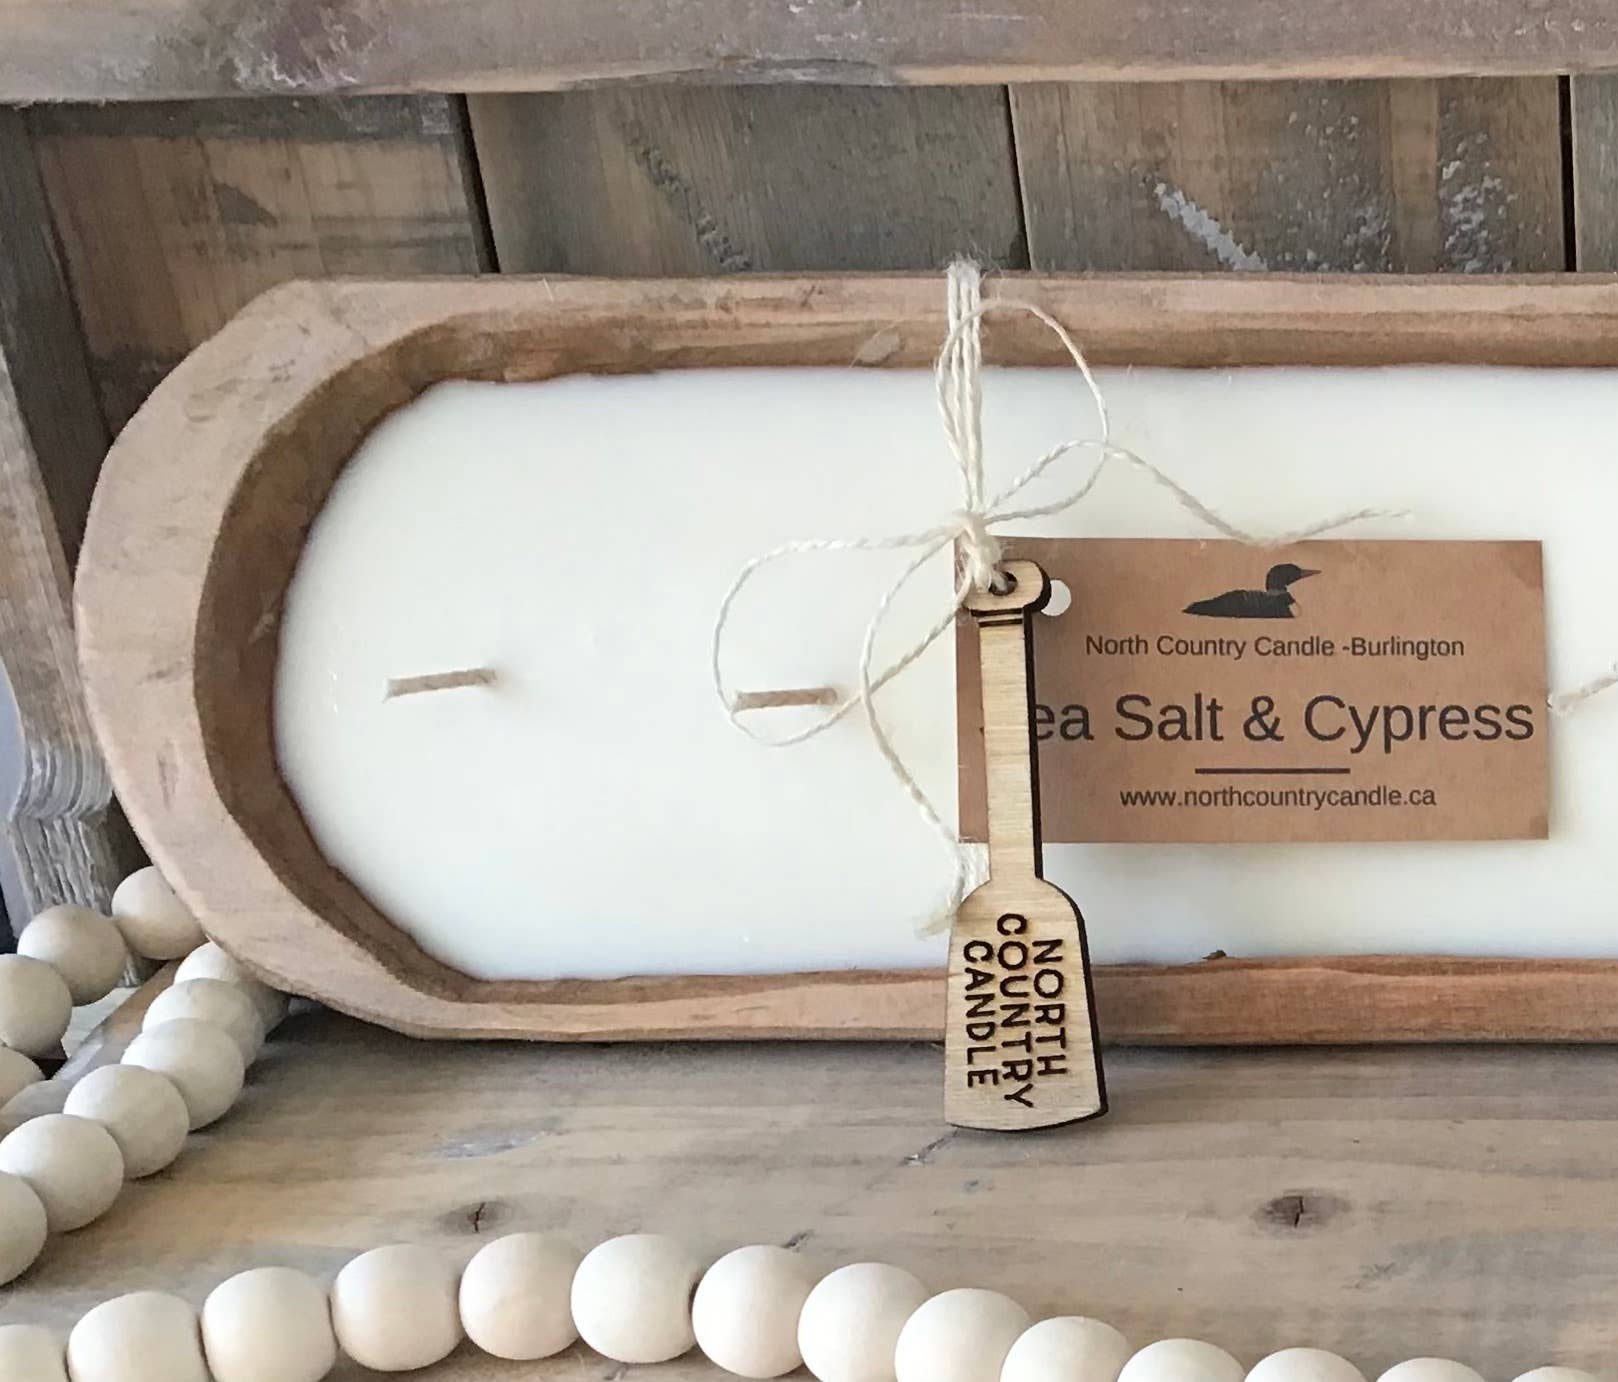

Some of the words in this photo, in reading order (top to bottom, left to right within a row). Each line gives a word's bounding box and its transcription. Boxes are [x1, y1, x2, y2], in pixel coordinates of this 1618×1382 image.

[1085, 635, 1148, 656] North
[1156, 635, 1246, 660] Country
[1253, 636, 1335, 658] Candle
[1342, 637, 1465, 660] -Burlington
[979, 703, 1094, 740] ea
[1115, 692, 1223, 741] Salt
[1242, 695, 1285, 741] &
[1304, 695, 1534, 754] Cypress
[1119, 785, 1437, 811] www.northcountrycandle.ca
[963, 940, 999, 1088] CANDLE
[996, 912, 1034, 1108] COUNTRY
[1032, 939, 1067, 1076] NORTH
